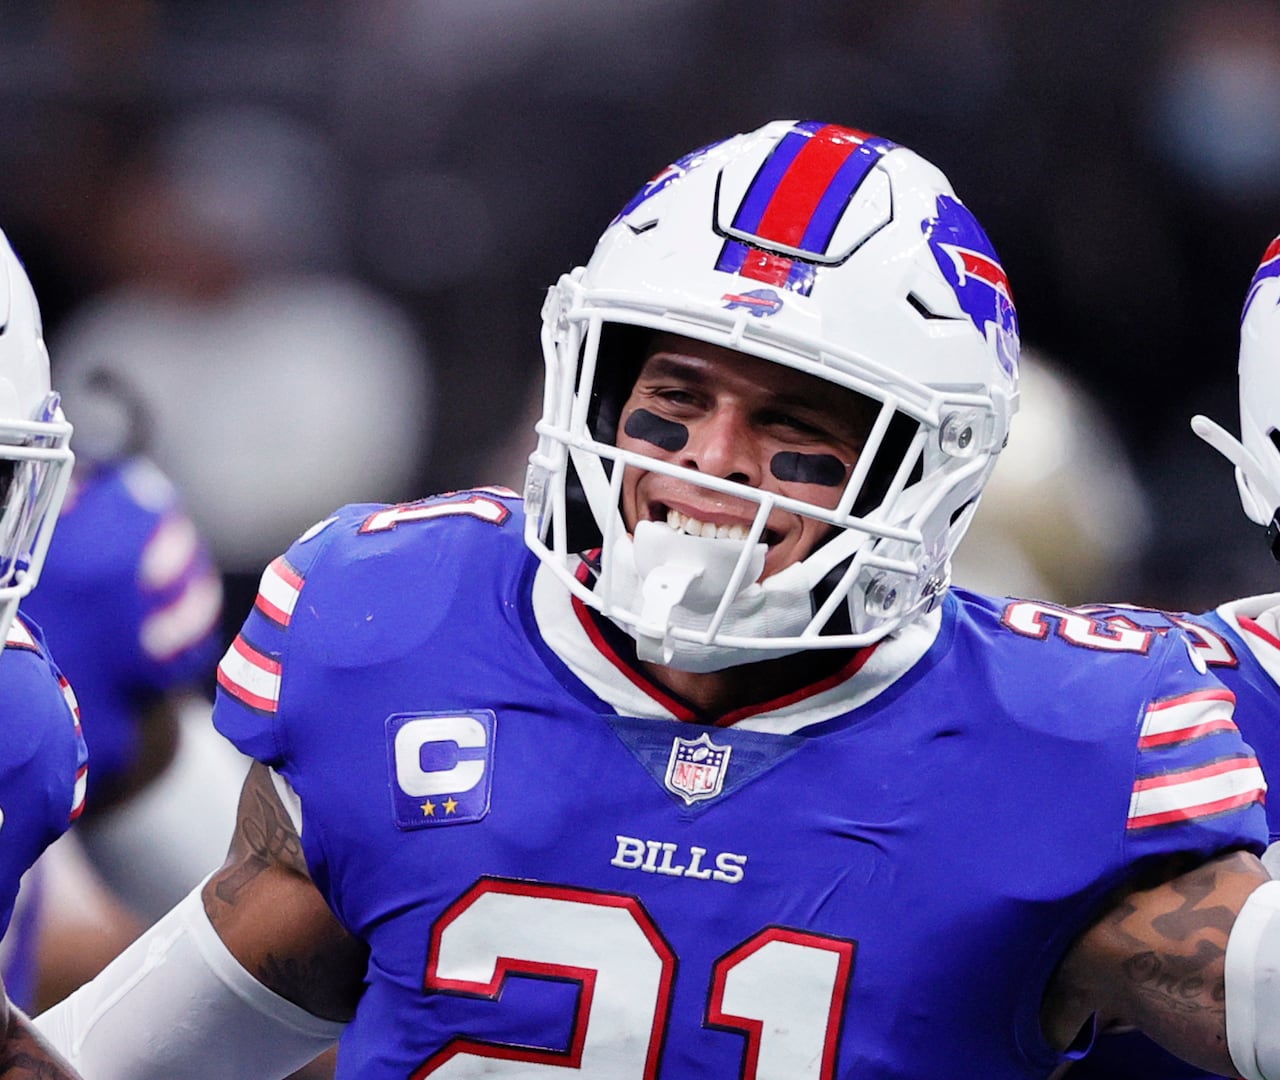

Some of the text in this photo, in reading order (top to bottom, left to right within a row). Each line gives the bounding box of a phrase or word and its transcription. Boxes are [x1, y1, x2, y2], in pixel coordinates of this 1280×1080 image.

[357, 486, 524, 536] 1
[1000, 597, 1153, 656] 2
[394, 716, 488, 797] C
[674, 760, 715, 791] NFL
[610, 835, 748, 884] BILLS
